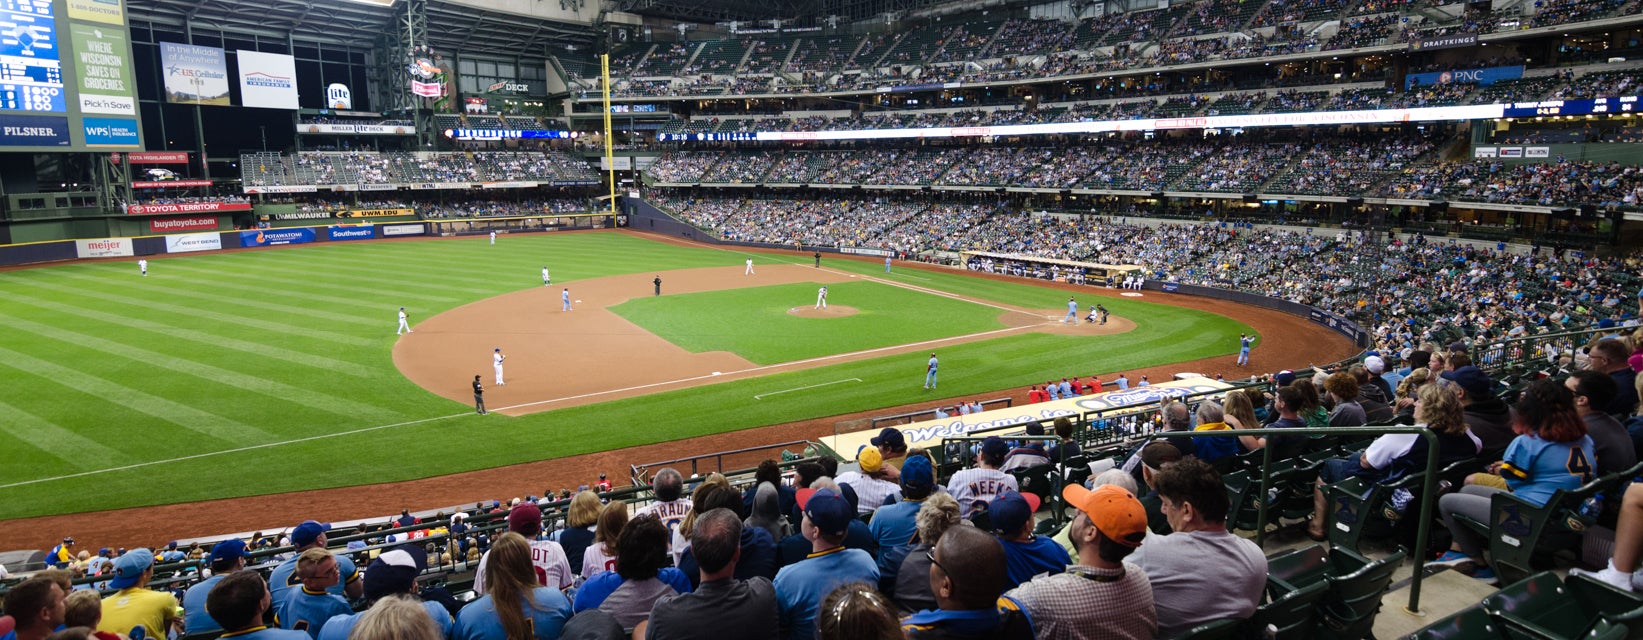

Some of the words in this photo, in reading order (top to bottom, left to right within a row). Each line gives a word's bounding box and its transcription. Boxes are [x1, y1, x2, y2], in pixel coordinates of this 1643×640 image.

[87, 40, 113, 54] WHERE
[1424, 37, 1475, 47] DRAFTKINGS
[192, 48, 219, 56] Middle
[80, 52, 122, 66] WISCONSIN
[179, 55, 219, 64] Anywhere
[86, 65, 109, 77] SAVES
[110, 67, 121, 78] ON
[1454, 70, 1483, 81] PNC
[505, 84, 529, 92] DECK
[330, 88, 348, 100] Lite
[84, 99, 102, 108] Pick
[4, 126, 57, 137] PILSNER.
[86, 126, 108, 136] WPS
[179, 203, 219, 211] TERRITORY
[154, 218, 215, 228] buyatoyota.com
[333, 229, 366, 238] Southwest
[88, 240, 121, 250] meijer
[902, 415, 1039, 443] Welcome
[1565, 445, 1593, 487] 4
[969, 480, 1013, 496] WEEK
[99, 581, 106, 590] 4
